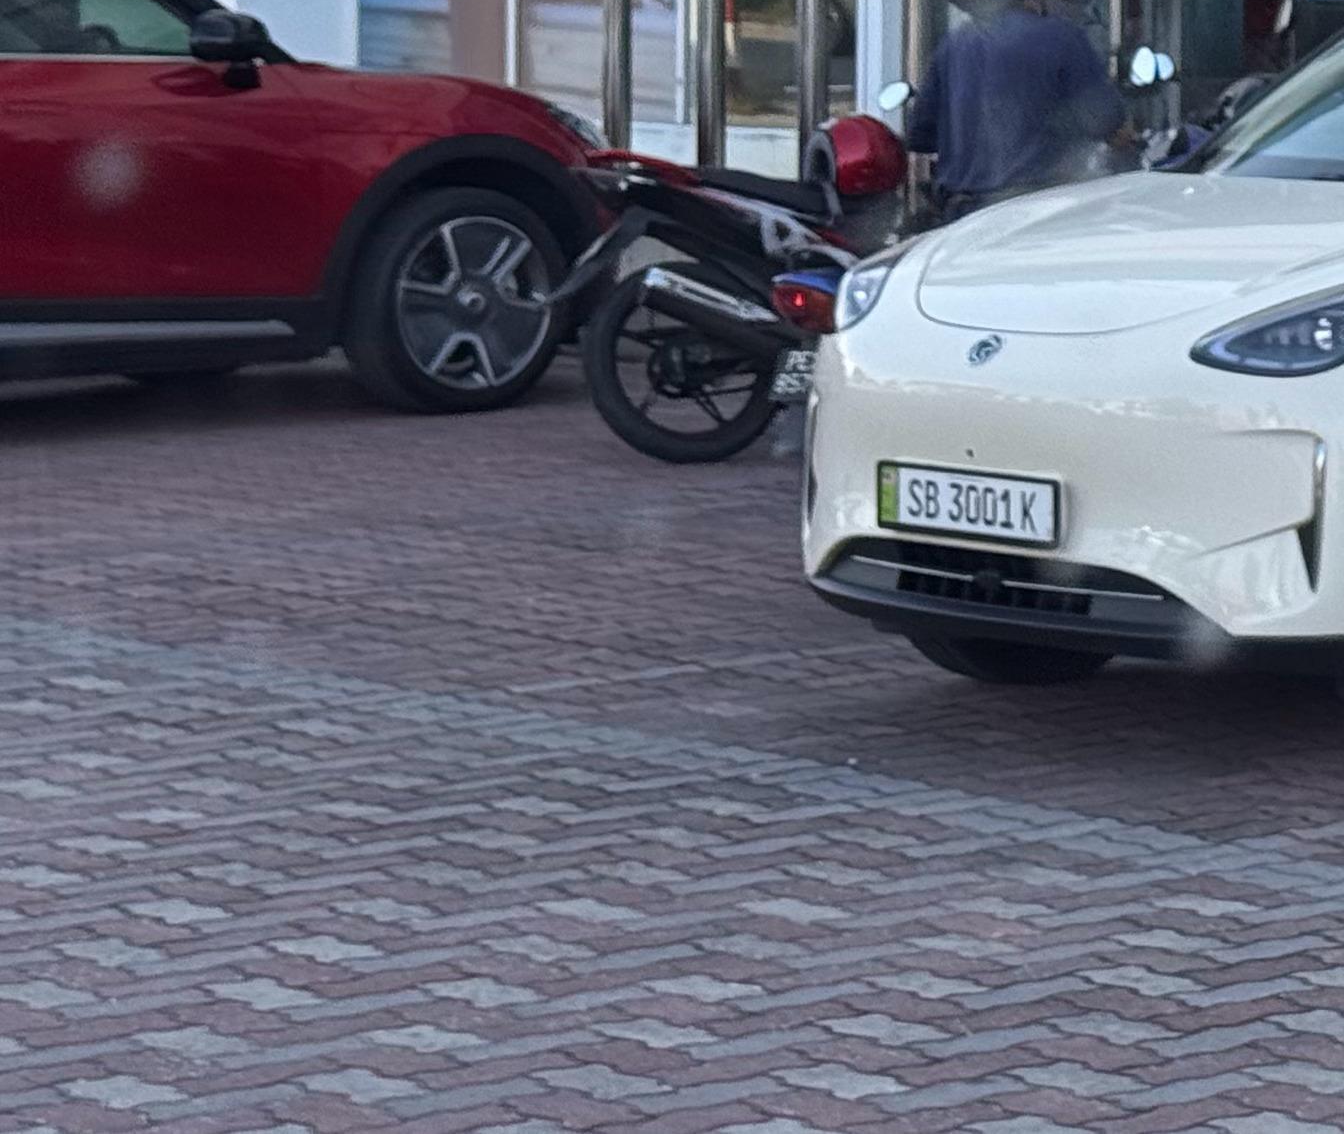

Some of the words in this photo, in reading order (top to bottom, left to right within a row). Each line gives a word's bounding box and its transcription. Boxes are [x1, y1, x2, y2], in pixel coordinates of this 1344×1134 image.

[907, 477, 941, 519] SB
[948, 481, 1014, 530] 3001
[1020, 489, 1038, 535] K
